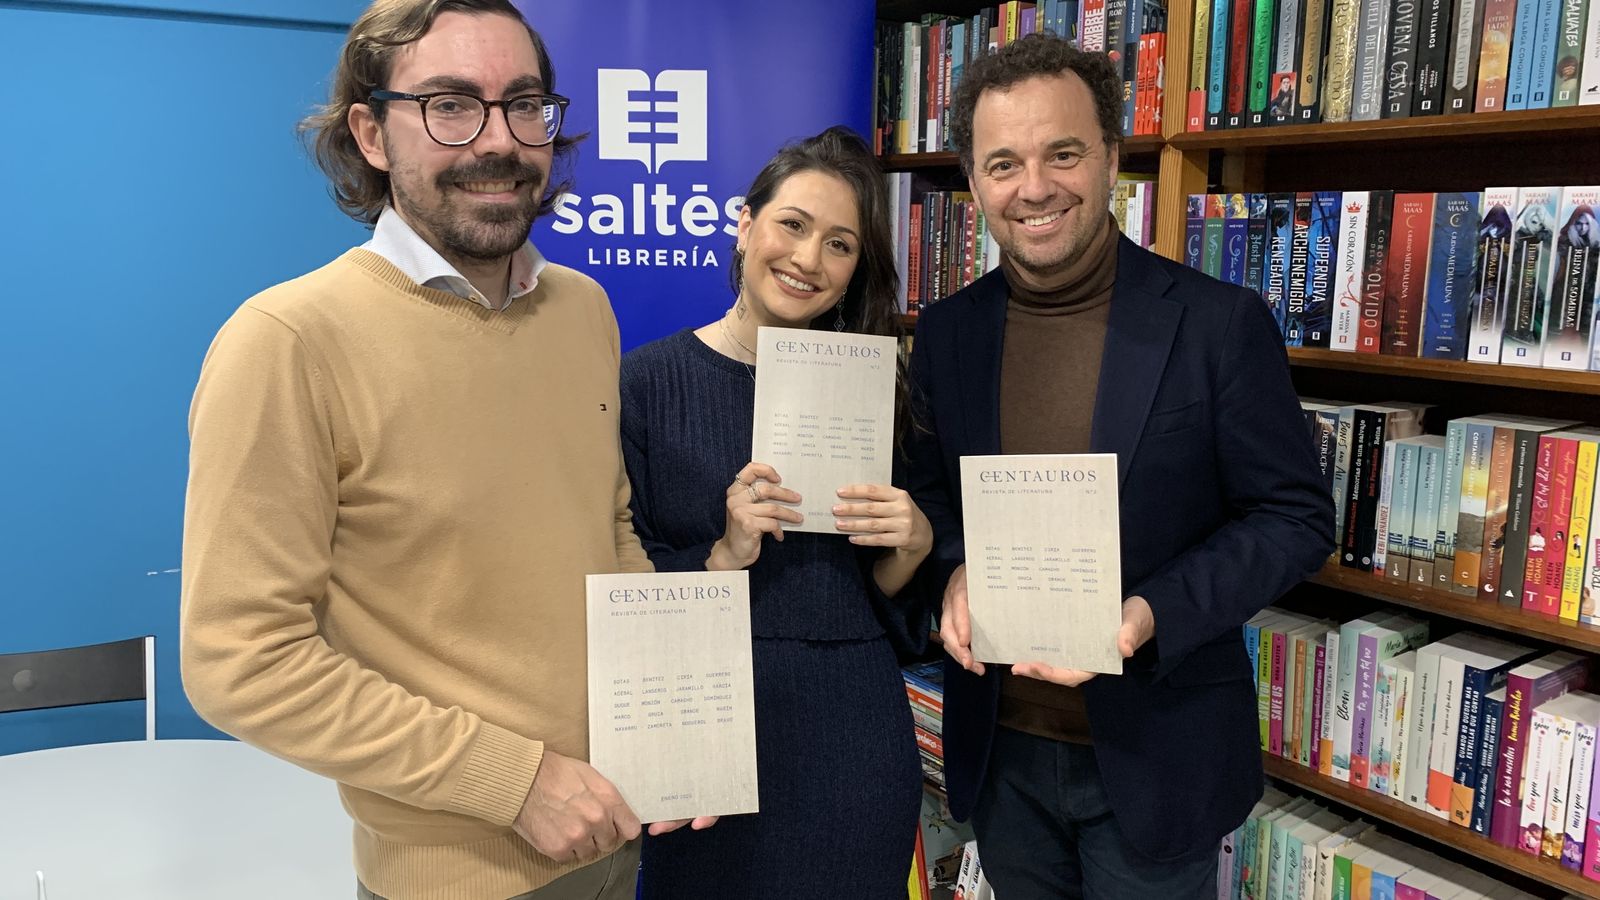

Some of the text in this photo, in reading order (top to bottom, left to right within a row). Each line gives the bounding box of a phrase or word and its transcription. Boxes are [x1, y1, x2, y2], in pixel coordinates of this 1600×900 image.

[1428, 12, 1438, 48] VILLANOS
[1520, 20, 1529, 45] LARGA
[1361, 34, 1376, 100] DEL INFIERNO
[1515, 48, 1526, 90] CONQUISTA
[1537, 45, 1548, 88] CONQUISTA
[1388, 61, 1408, 100] CASA
[589, 246, 718, 267] LIBRERÍA
[1346, 231, 1356, 272] CORAZÓN
[1376, 230, 1385, 271] CORONA
[1268, 237, 1285, 301] RENEGADOS
[1289, 224, 1308, 313] ARCHIENEMIGOS
[1312, 236, 1330, 302] SUPERNOVA
[1401, 253, 1412, 299] MEDIALUNA
[1444, 254, 1455, 303] MEDIALUNA
[1364, 273, 1382, 328] OLVIDO
[1566, 249, 1582, 328] REINA SOMBRAS
[776, 341, 880, 358] CENTAUROS
[1358, 420, 1366, 442] salvaje
[1471, 432, 1479, 464] CONTANDO
[1355, 458, 1361, 466] de
[1538, 468, 1549, 481] del
[980, 470, 1096, 482] CENTAUROS
[1352, 467, 1361, 500] Memorias
[1555, 474, 1568, 486] del
[1537, 498, 1548, 508] El
[1556, 517, 1565, 525] El
[1526, 557, 1534, 582] HELEN
[1534, 557, 1543, 584] HOANG
[1545, 562, 1553, 586] HELEN
[1554, 562, 1562, 589] HOANG
[1572, 566, 1581, 594] HOANG
[609, 585, 730, 603] CENTAUROS
[1272, 685, 1283, 721] SAVE US
[1463, 686, 1472, 699] MÁS
[1471, 690, 1480, 713] CONTAR
[1508, 690, 1522, 720] Rubiales
[1258, 700, 1269, 721] SAVE
[1462, 701, 1471, 723] QUEDEN
[1461, 725, 1468, 733] NO
[1467, 729, 1476, 759] ESTRELLAS
[1530, 782, 1541, 796] you
[1573, 793, 1585, 809] you
[1526, 798, 1536, 812] love
[1550, 787, 1563, 822] need you
[1571, 811, 1580, 828] miss
